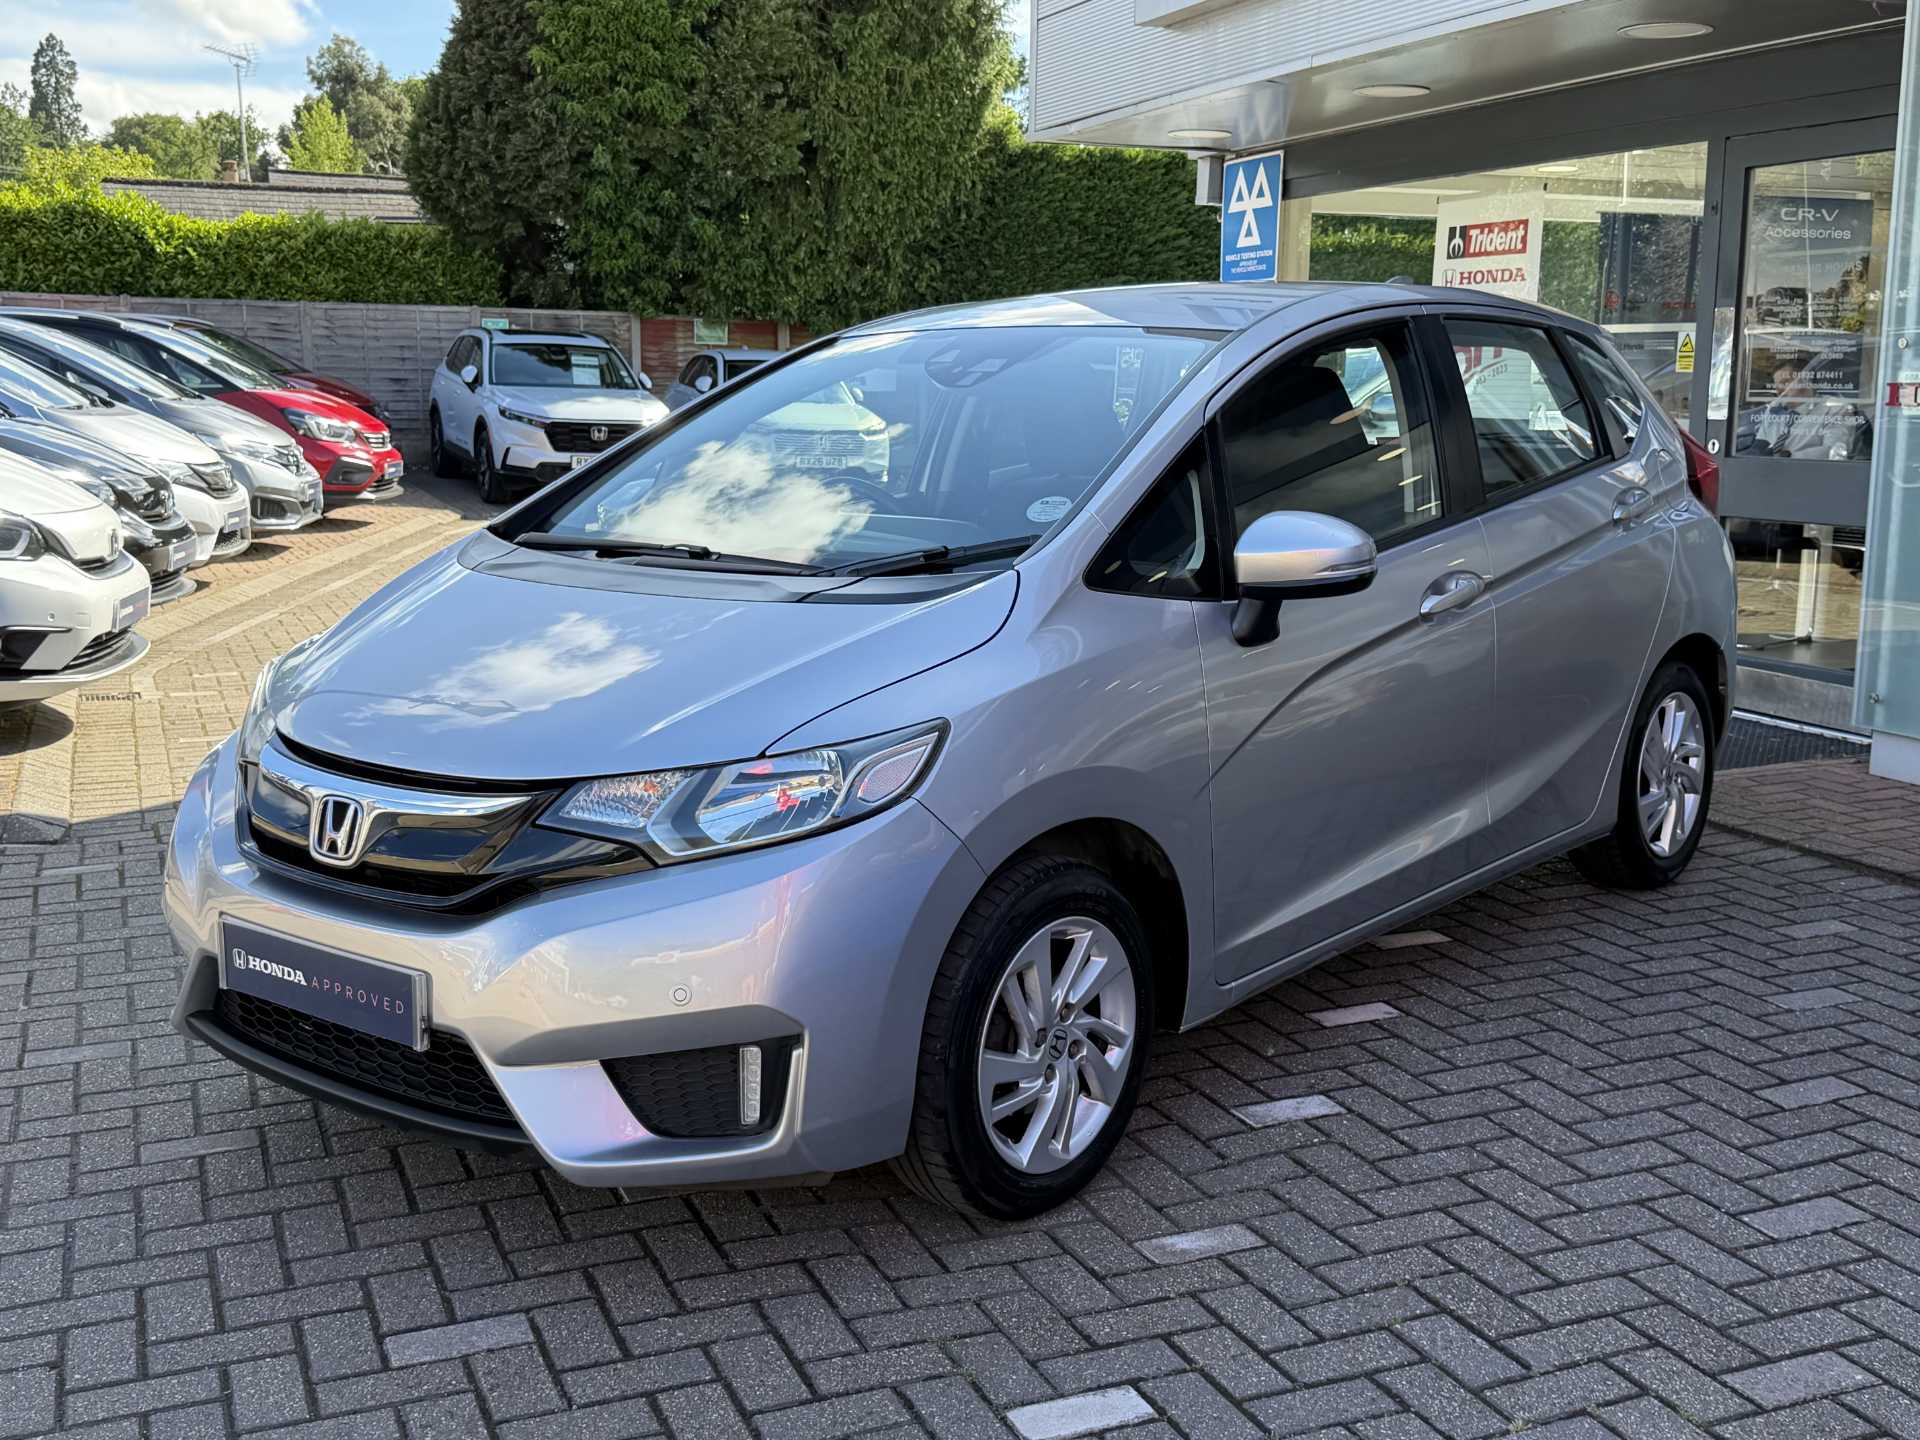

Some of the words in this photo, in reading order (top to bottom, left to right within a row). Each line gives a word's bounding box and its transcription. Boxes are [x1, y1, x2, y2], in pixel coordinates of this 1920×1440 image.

[1780, 207, 1840, 222] CR-V
[1470, 225, 1524, 253] Trident
[1765, 226, 1851, 240] Accessories
[1458, 267, 1527, 285] HONDA
[248, 955, 308, 987] HONDA
[311, 976, 405, 1015] APPROVED
